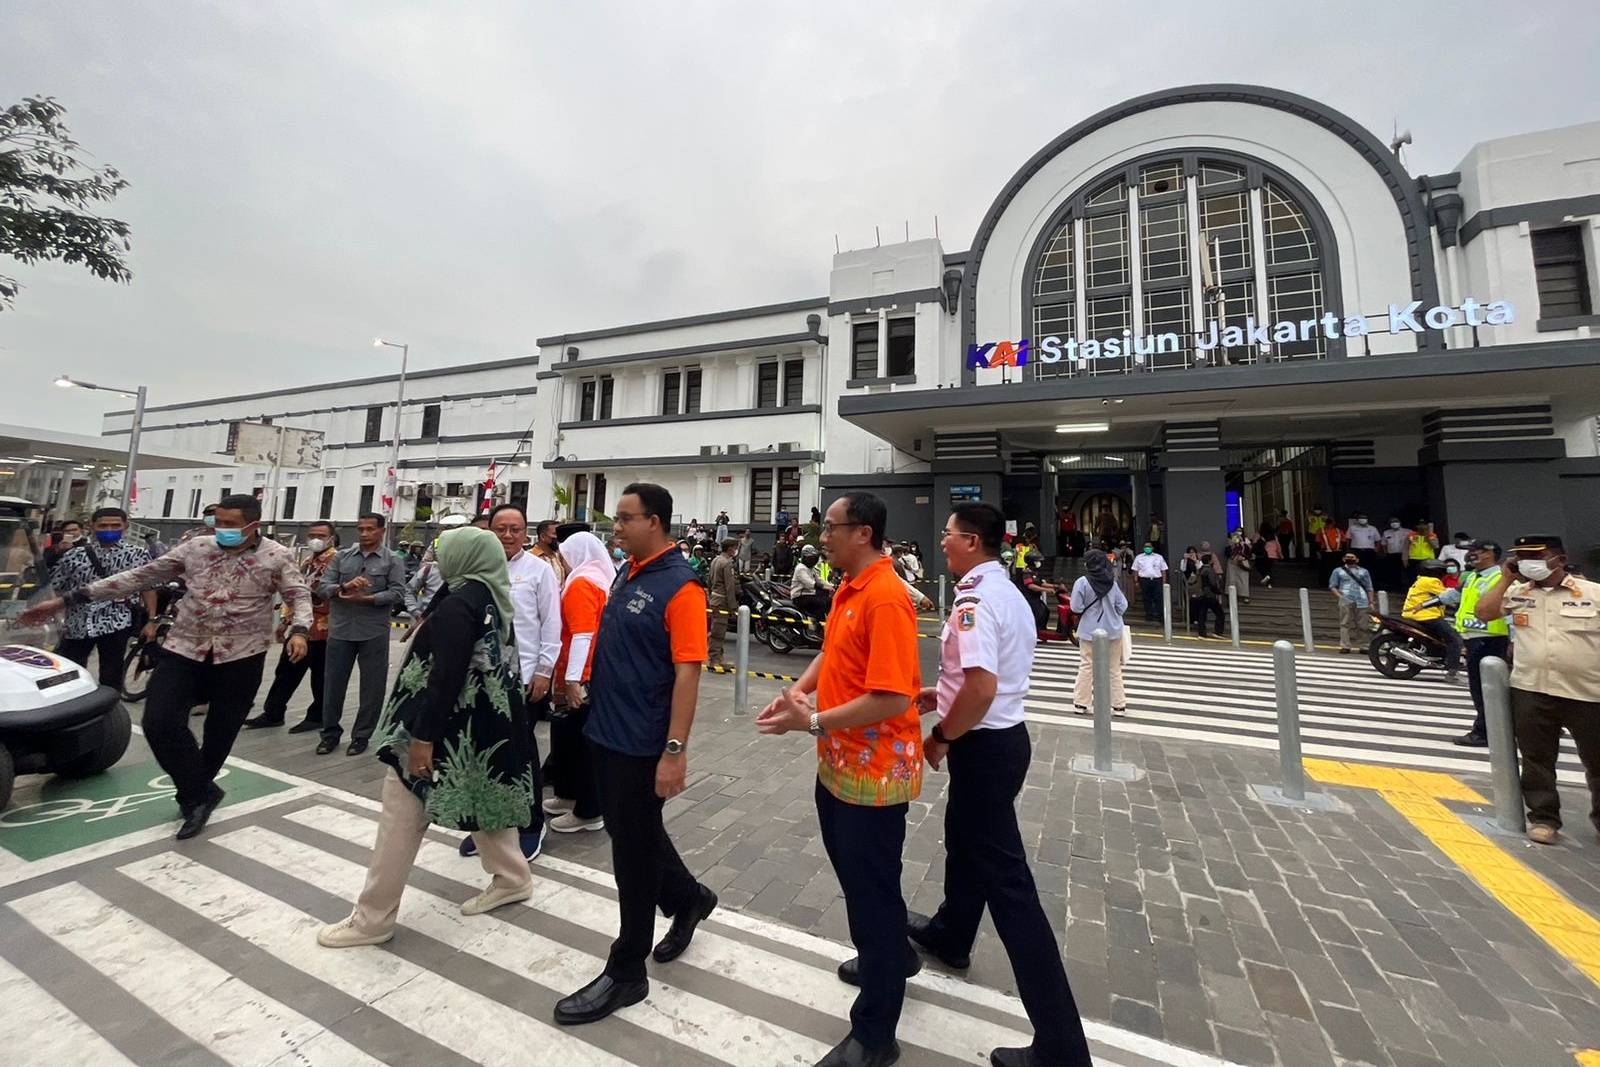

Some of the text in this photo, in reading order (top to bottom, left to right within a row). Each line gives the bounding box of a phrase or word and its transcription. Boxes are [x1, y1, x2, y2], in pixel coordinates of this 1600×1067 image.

[966, 297, 1514, 371] KAI Stasiun Jakarta Kota
